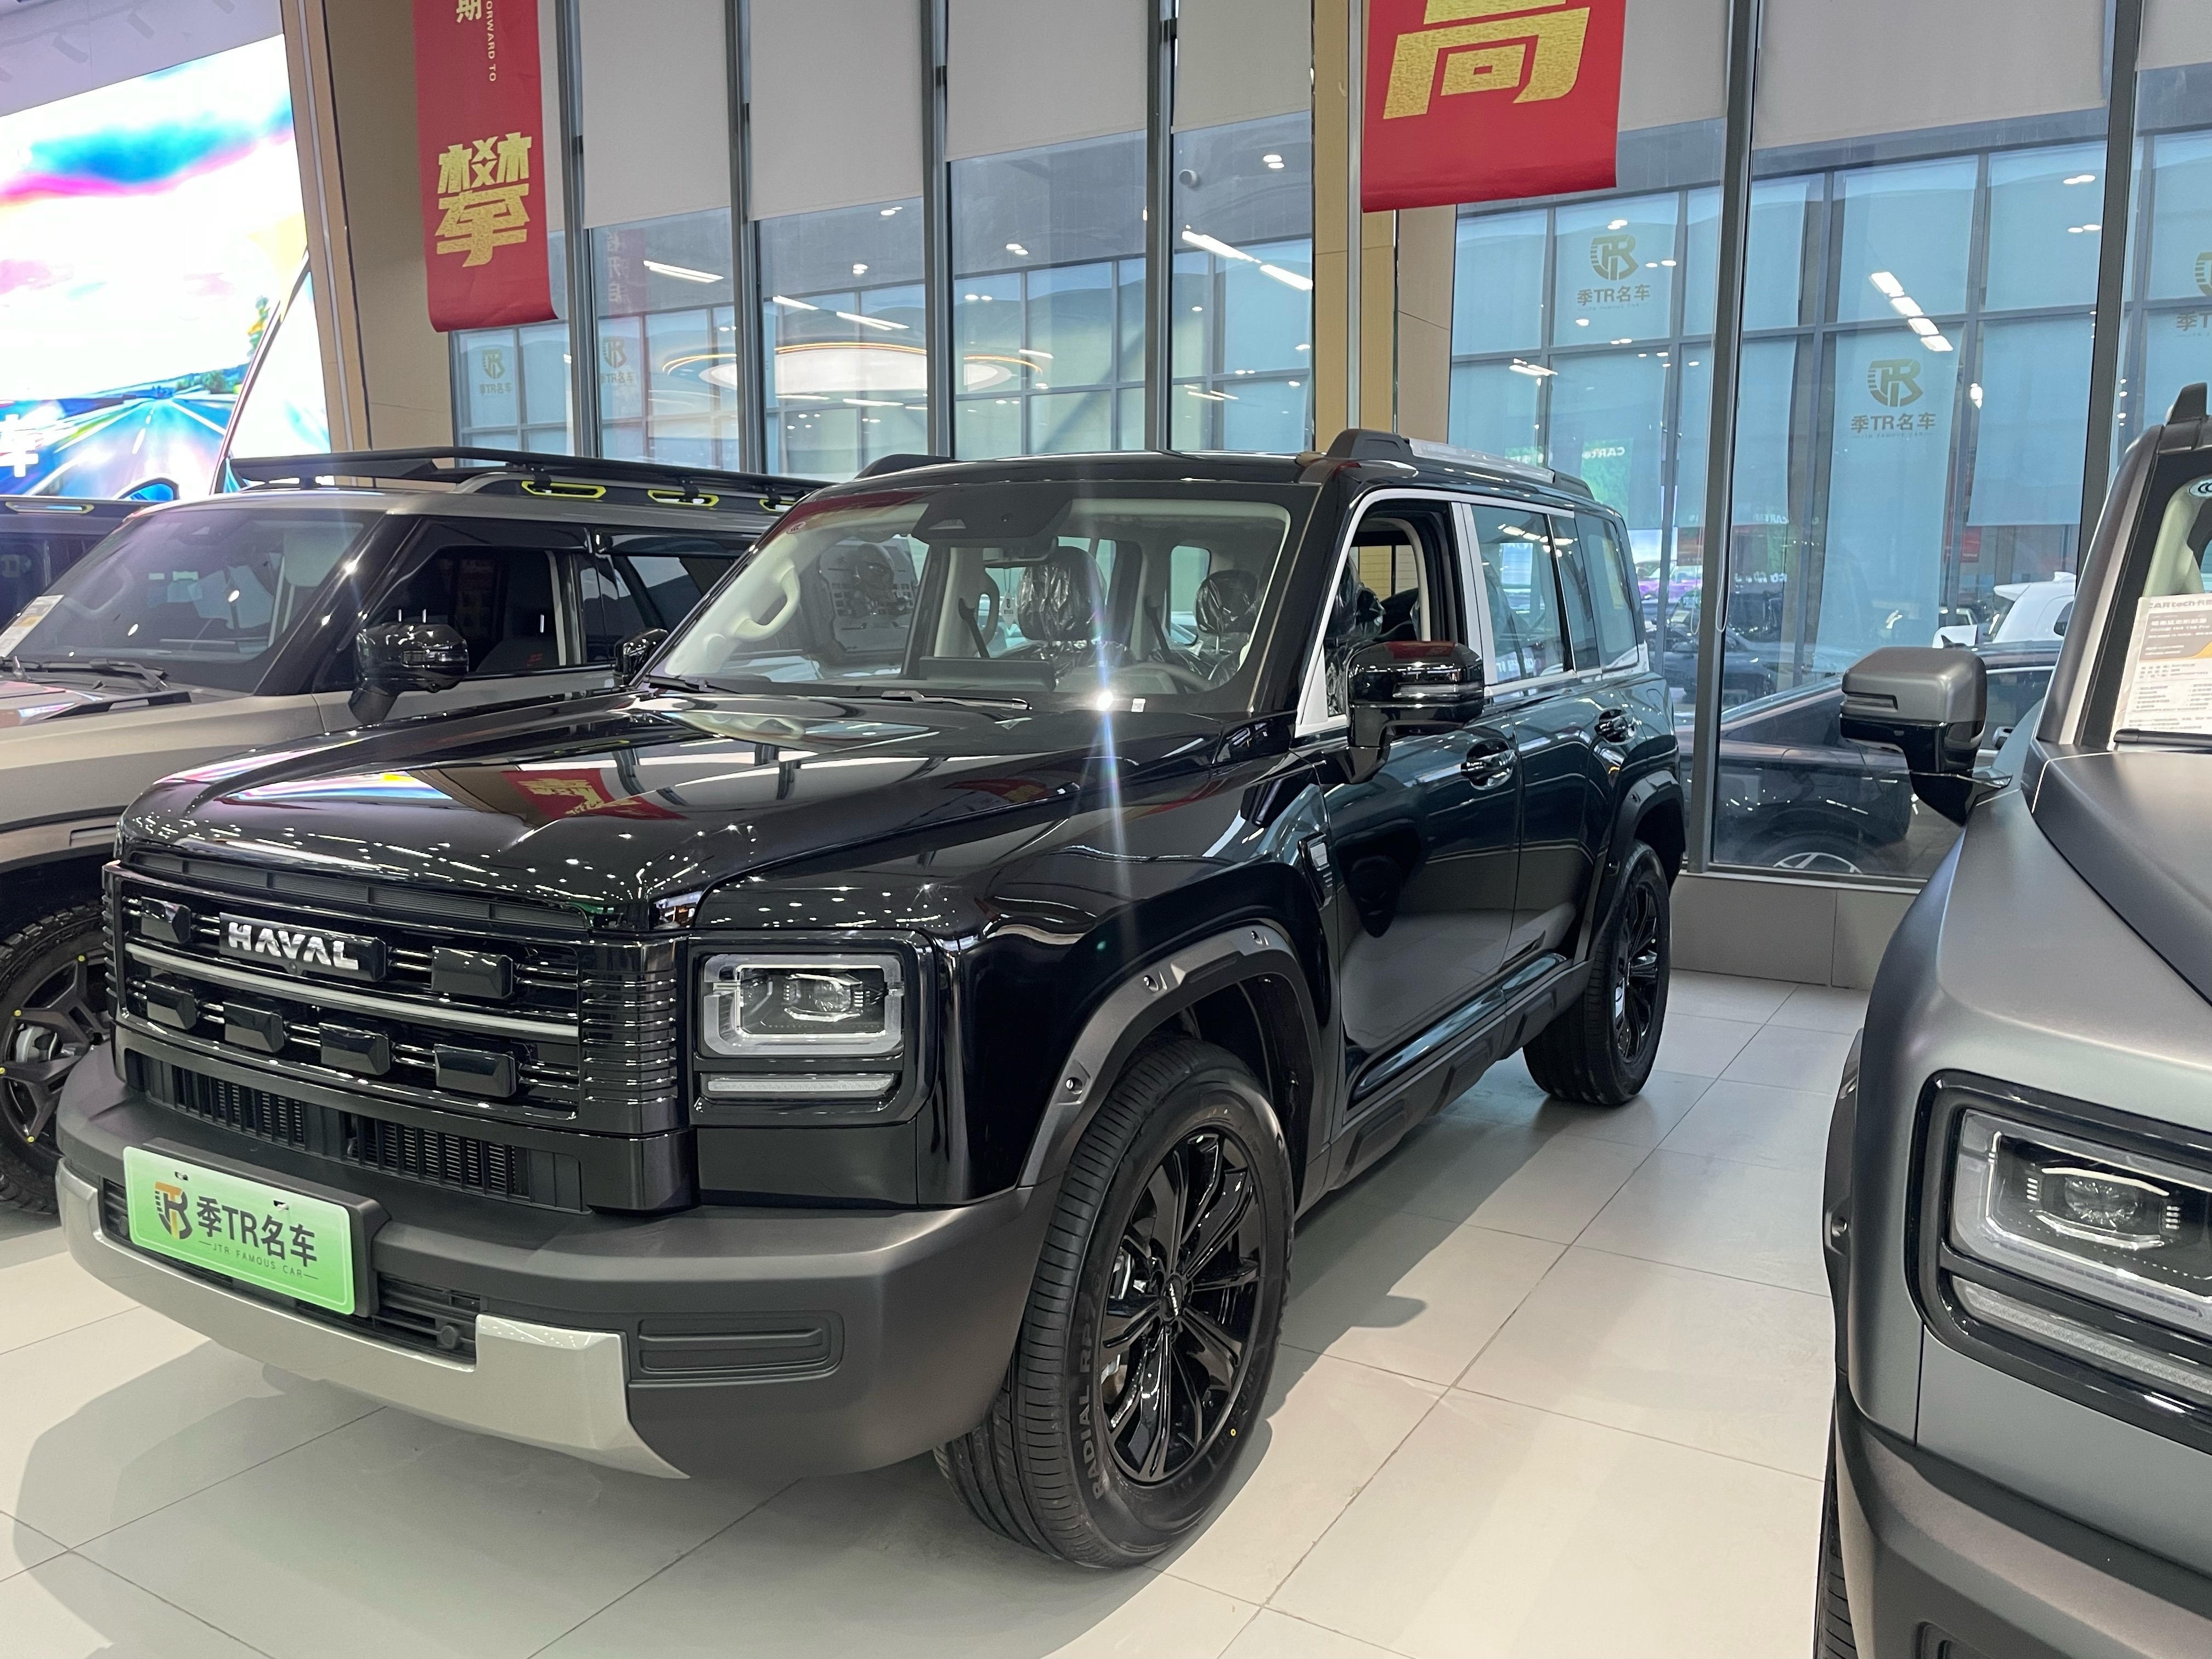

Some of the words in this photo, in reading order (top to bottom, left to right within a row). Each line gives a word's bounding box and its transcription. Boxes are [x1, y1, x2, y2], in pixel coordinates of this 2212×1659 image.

[489, 64, 496, 82] TO
[435, 132, 532, 267] 攀
[1577, 284, 1651, 306] 季TR名车
[1851, 412, 1937, 433] 季TR名车
[228, 922, 359, 970] HAVAL
[196, 1195, 318, 1267] 季TR名车
[213, 1243, 230, 1255] JTR
[236, 1250, 276, 1269] FAMOUS
[283, 1265, 302, 1278] CAR
[1079, 1385, 1105, 1499] RADIAL
